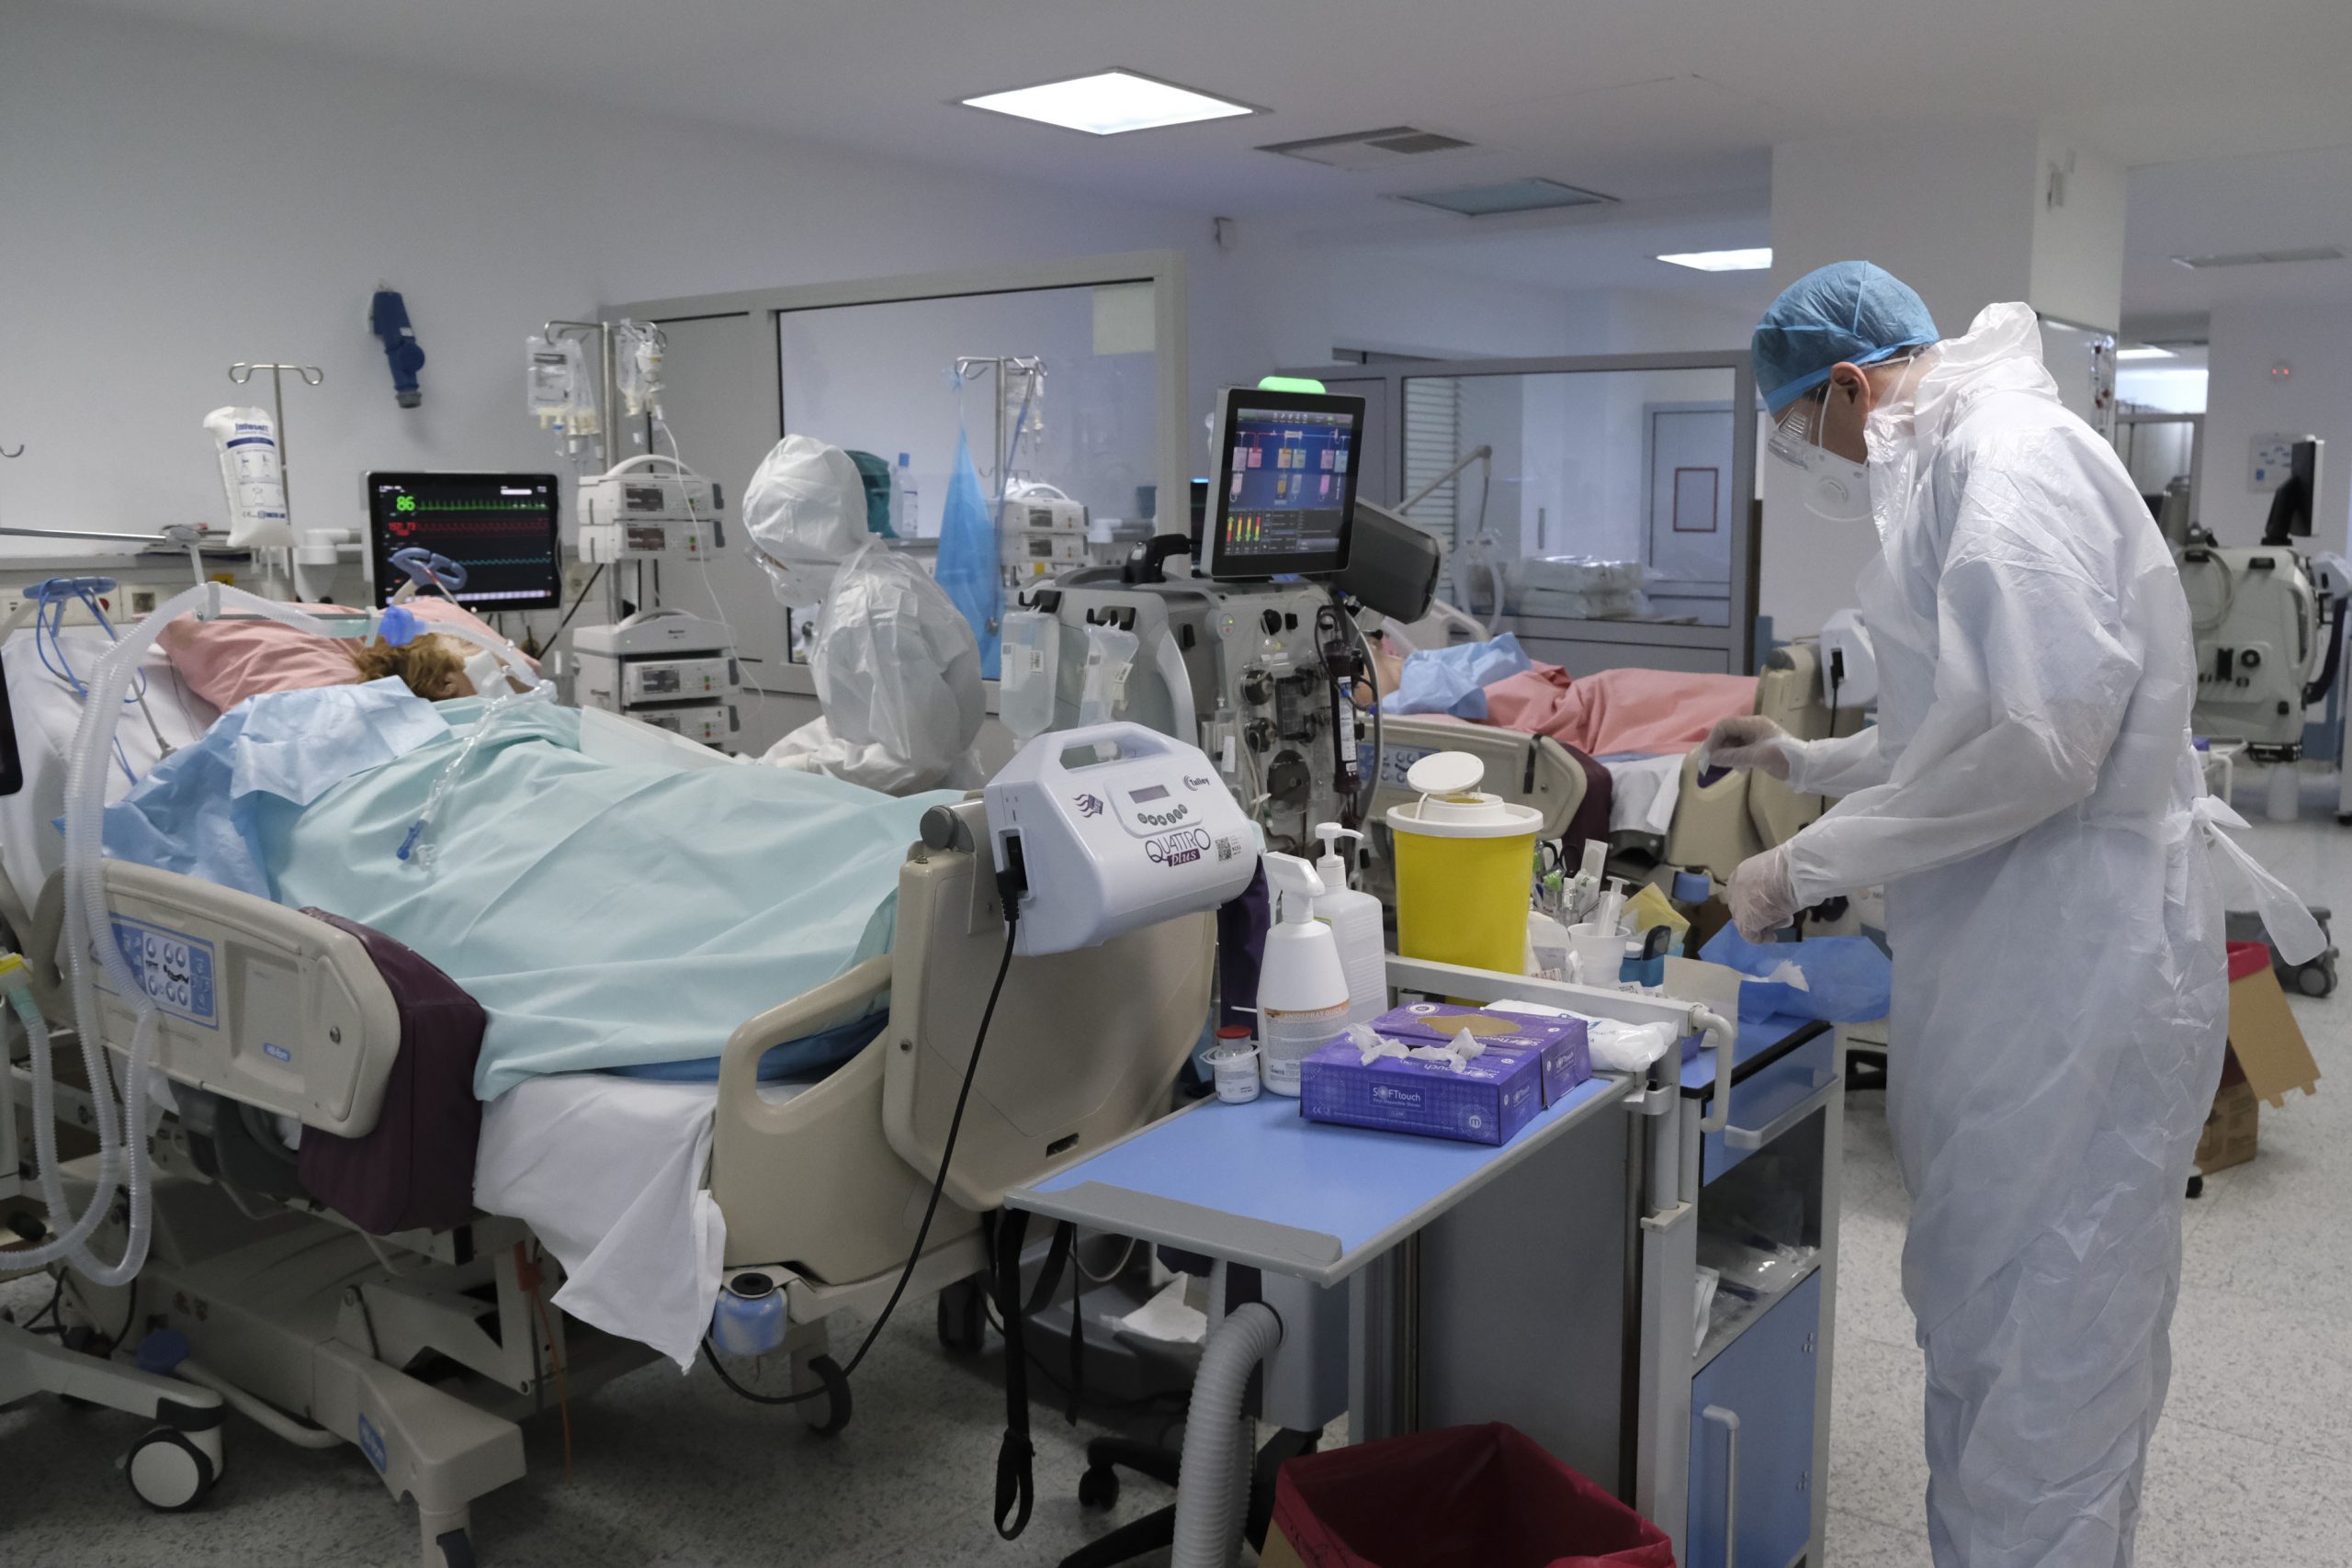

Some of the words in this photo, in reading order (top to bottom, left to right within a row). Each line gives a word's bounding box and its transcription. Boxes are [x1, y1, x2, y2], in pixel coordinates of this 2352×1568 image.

[396, 495, 416, 512] 86
[1189, 777, 1211, 787] Talley
[1170, 850, 1197, 867] plus
[1373, 1086, 1420, 1102] SOFTtouch
